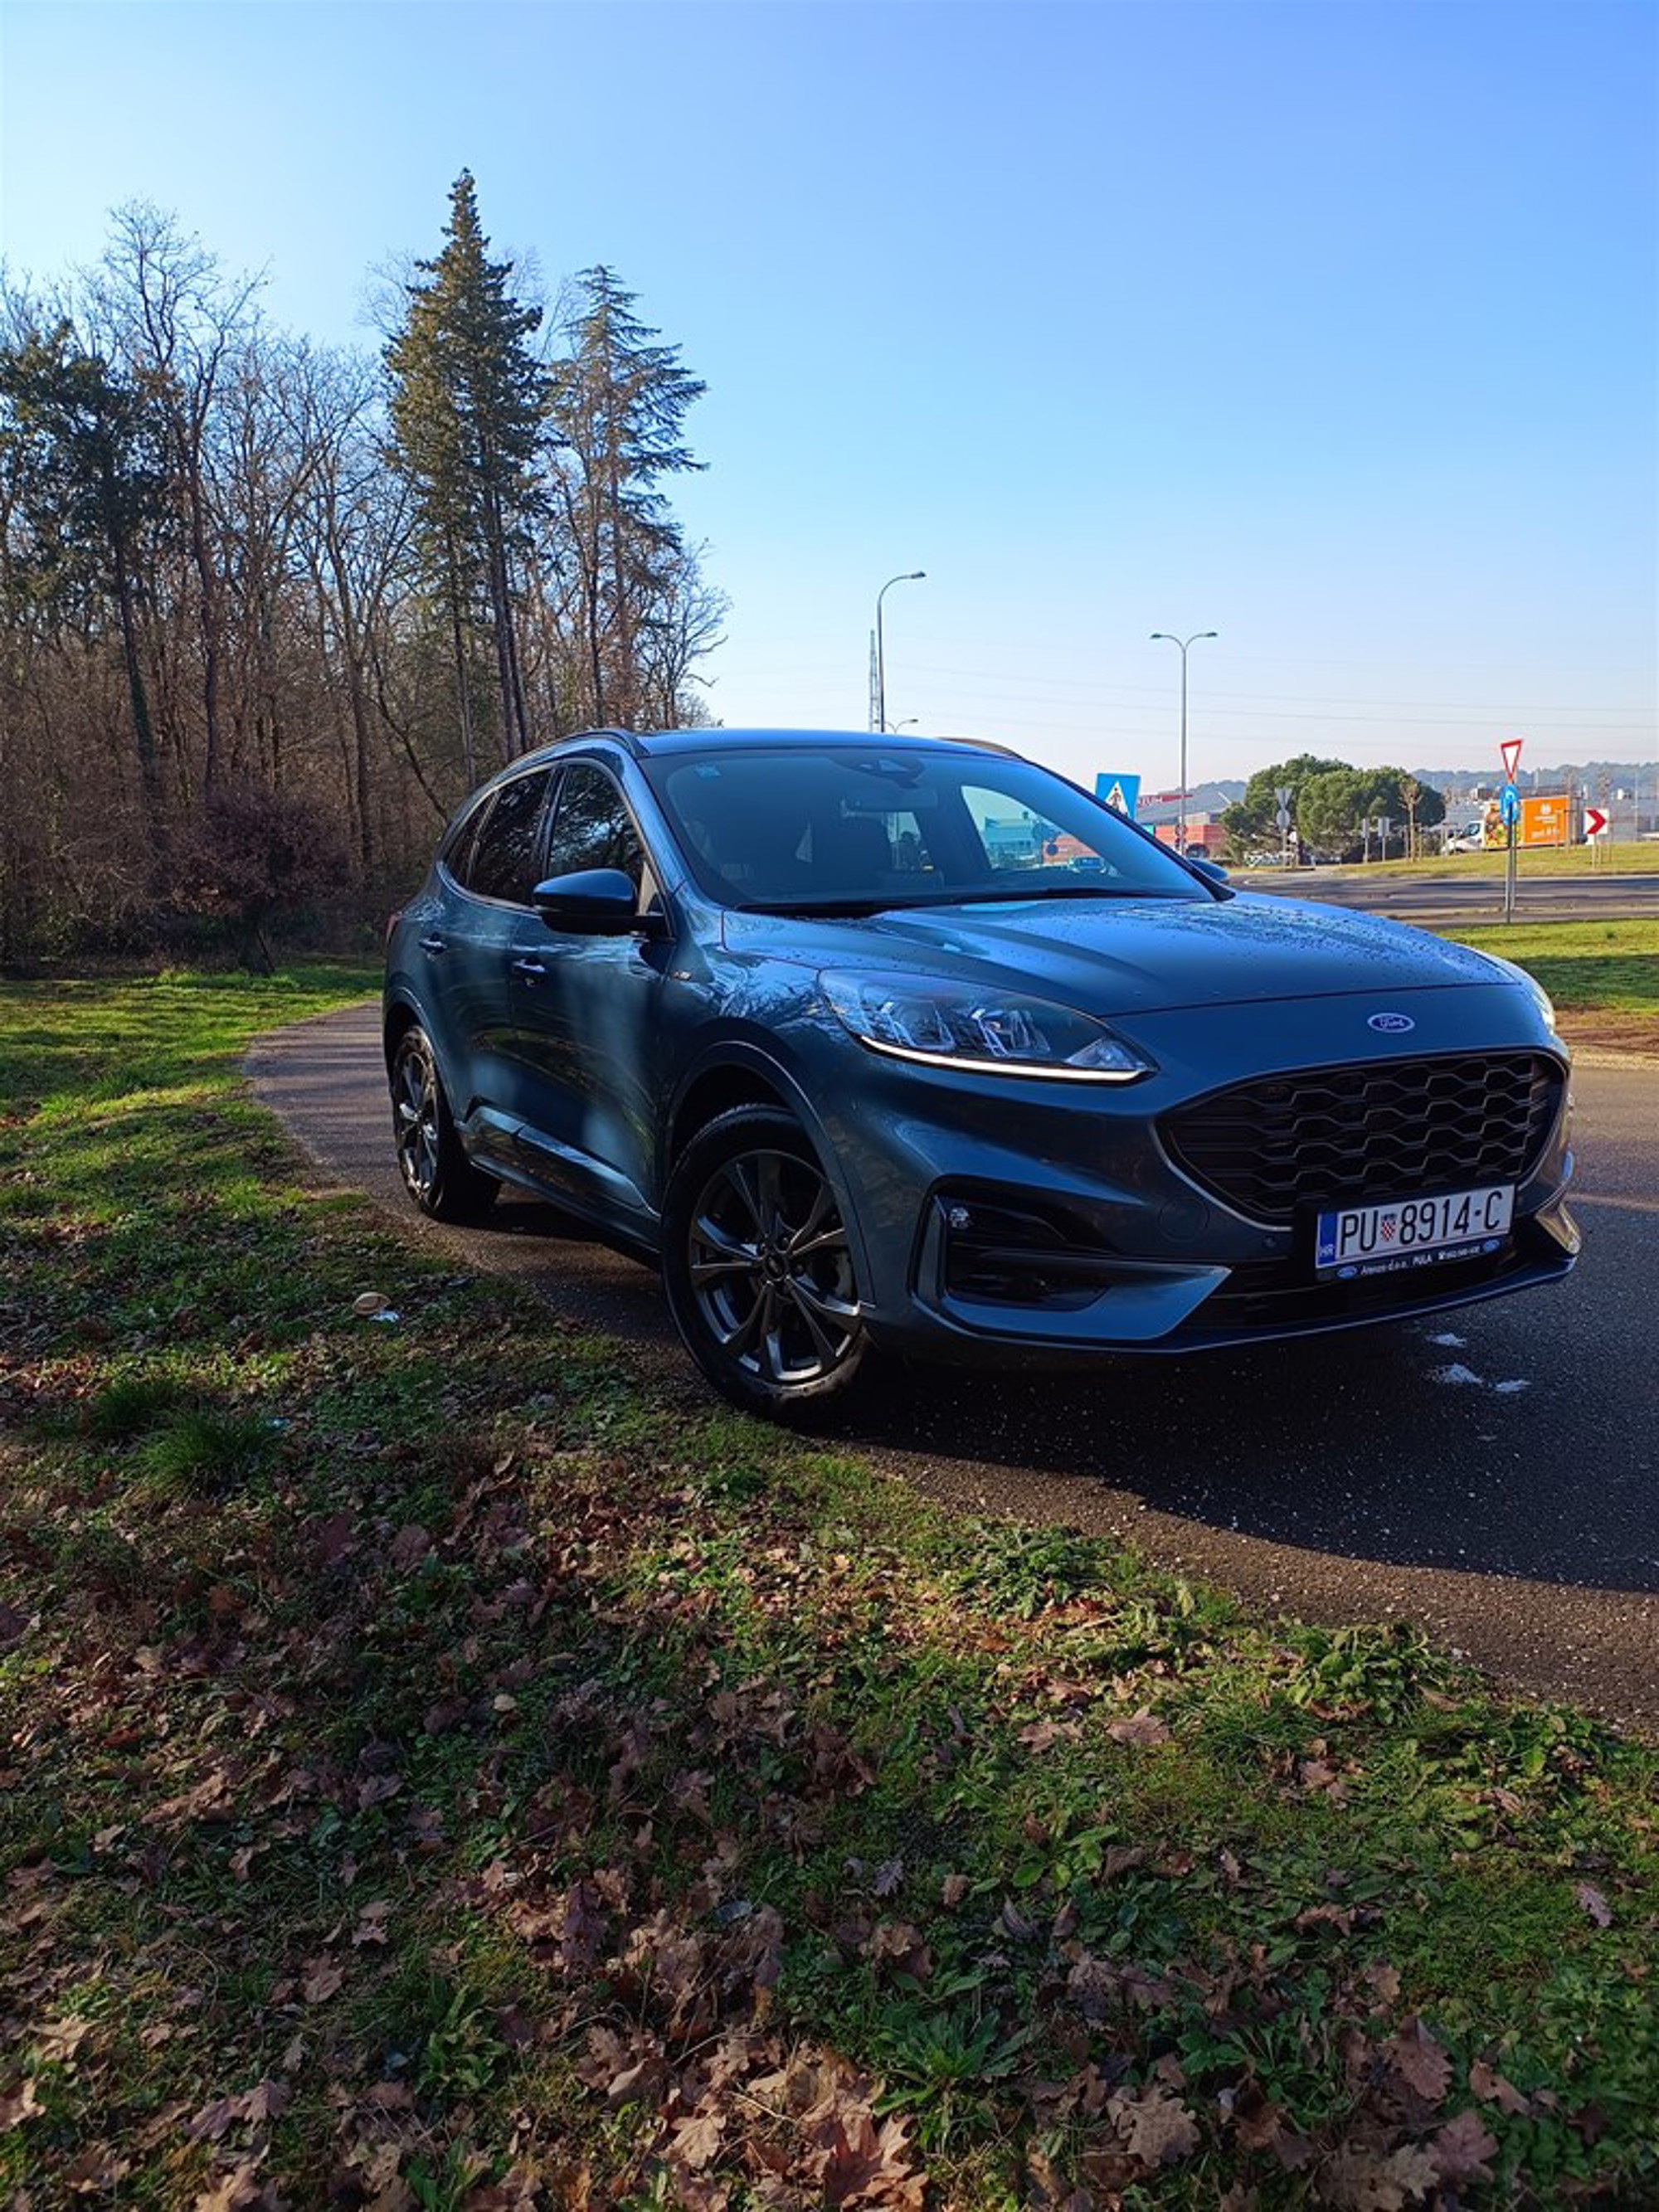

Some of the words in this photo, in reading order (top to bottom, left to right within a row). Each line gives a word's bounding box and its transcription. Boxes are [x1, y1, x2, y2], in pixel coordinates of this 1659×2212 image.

[1340, 1210, 1379, 1257] PU
[1399, 1191, 1503, 1245] 8914-C
[1319, 1243, 1335, 1257] HR
